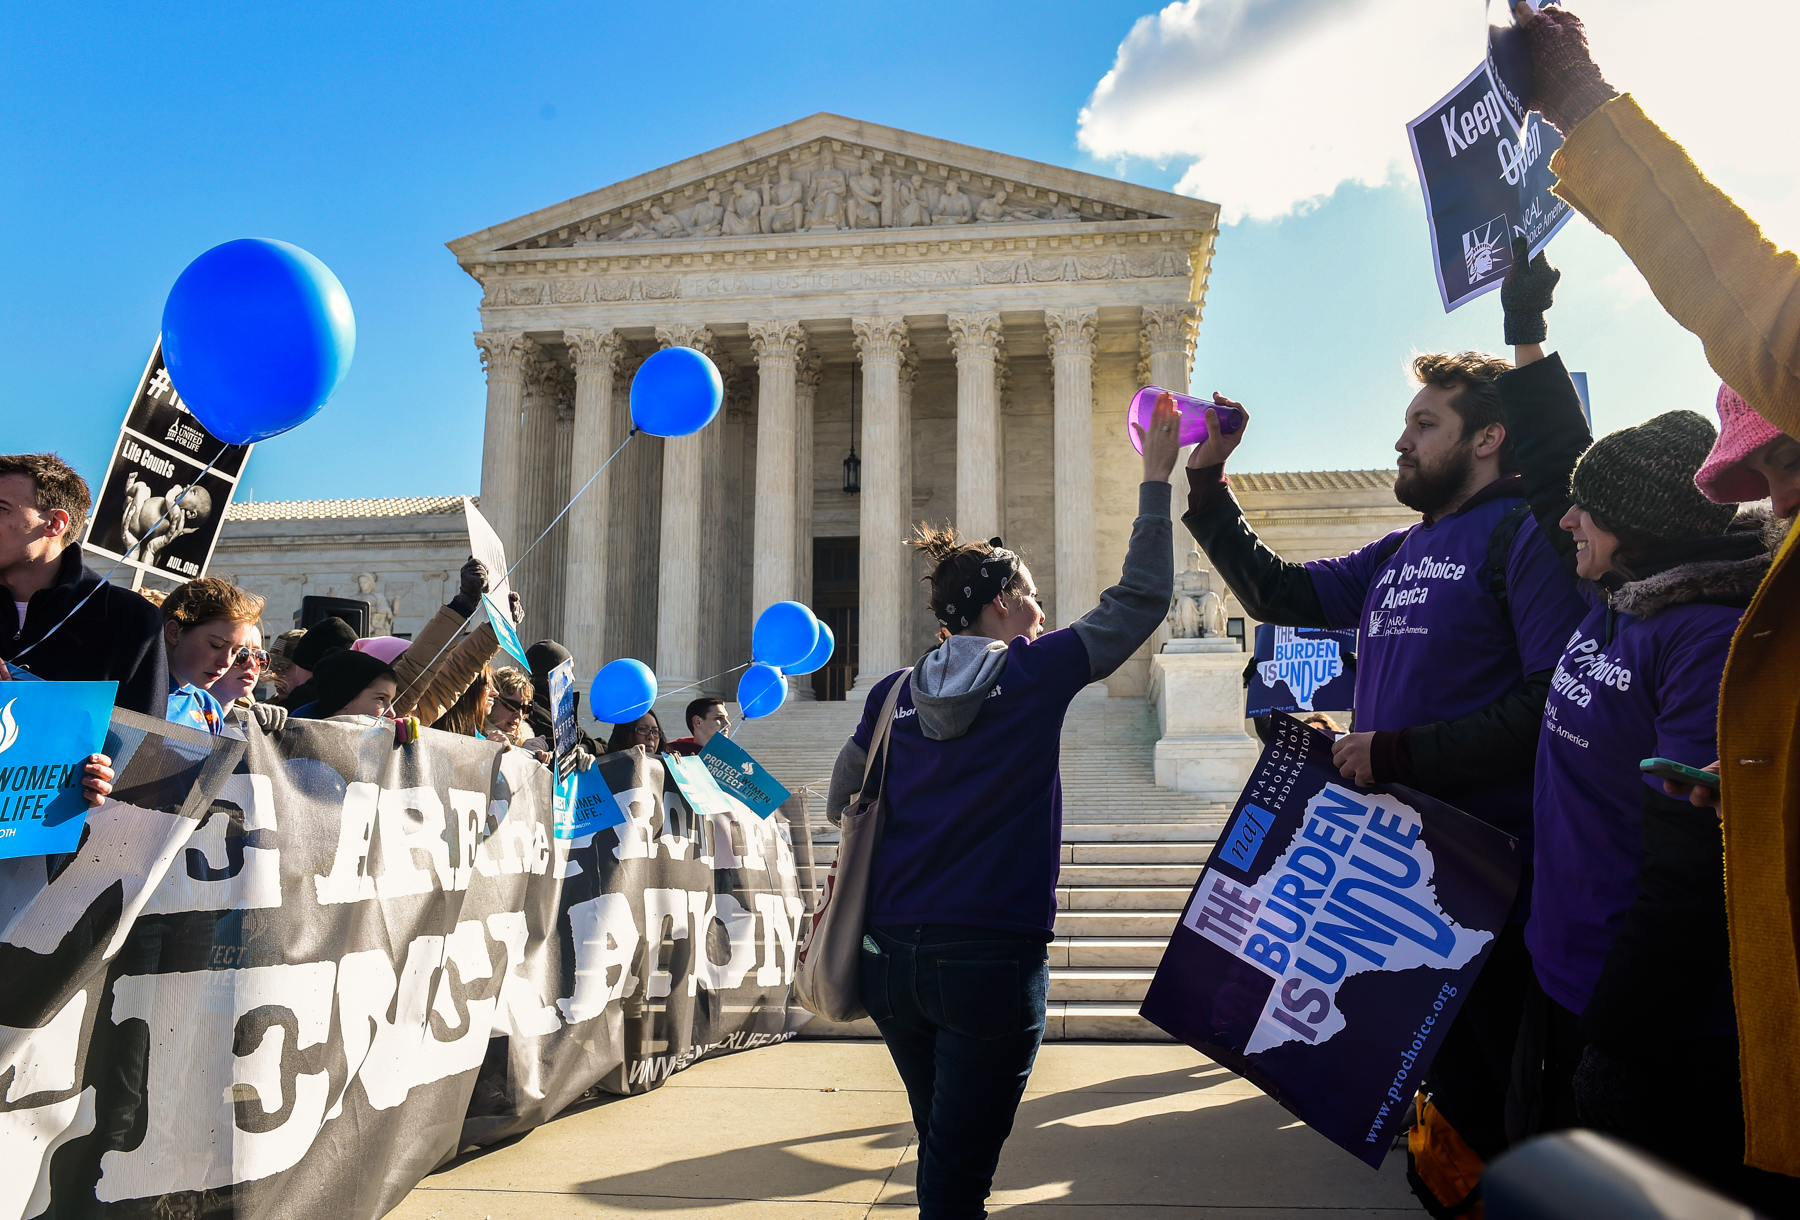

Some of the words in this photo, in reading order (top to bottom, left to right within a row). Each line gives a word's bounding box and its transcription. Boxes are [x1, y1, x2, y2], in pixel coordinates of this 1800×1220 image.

[1440, 90, 1502, 158] Keep
[695, 277, 760, 293] EQUAL
[764, 273, 840, 290] JUSTICE
[850, 269, 916, 286] UNDER
[923, 268, 960, 283] LAW
[175, 436, 188, 447] FOR
[186, 441, 200, 453] LIFE
[178, 428, 203, 444] UNITED
[121, 440, 141, 463] Life
[140, 449, 175, 479] Counts
[166, 555, 199, 577] AUL.ORG
[1275, 642, 1337, 662] BURDEN
[1276, 626, 1293, 644] THE
[1264, 664, 1277, 682] IS
[1279, 660, 1338, 703] UNDUE
[555, 714, 575, 740] BETTER
[1556, 725, 1589, 749] America
[703, 753, 743, 779] PROTECT
[741, 776, 771, 805] WOMEN.
[1251, 720, 1287, 799] NATIONAL
[1263, 723, 1299, 805] ABORTION
[1273, 729, 1311, 810] FEDERATION
[0, 794, 49, 822] LIFE.
[576, 806, 602, 822] LIFE.
[741, 787, 760, 805] LIFE.
[314, 782, 488, 905] ARE
[1231, 803, 1268, 861] naf
[1243, 788, 1368, 976] BURDEN
[1295, 805, 1457, 985] UNDUE
[1195, 877, 1262, 947] THE
[1272, 977, 1331, 1042] IS
[1366, 982, 1458, 1143] www.prochoice.org
